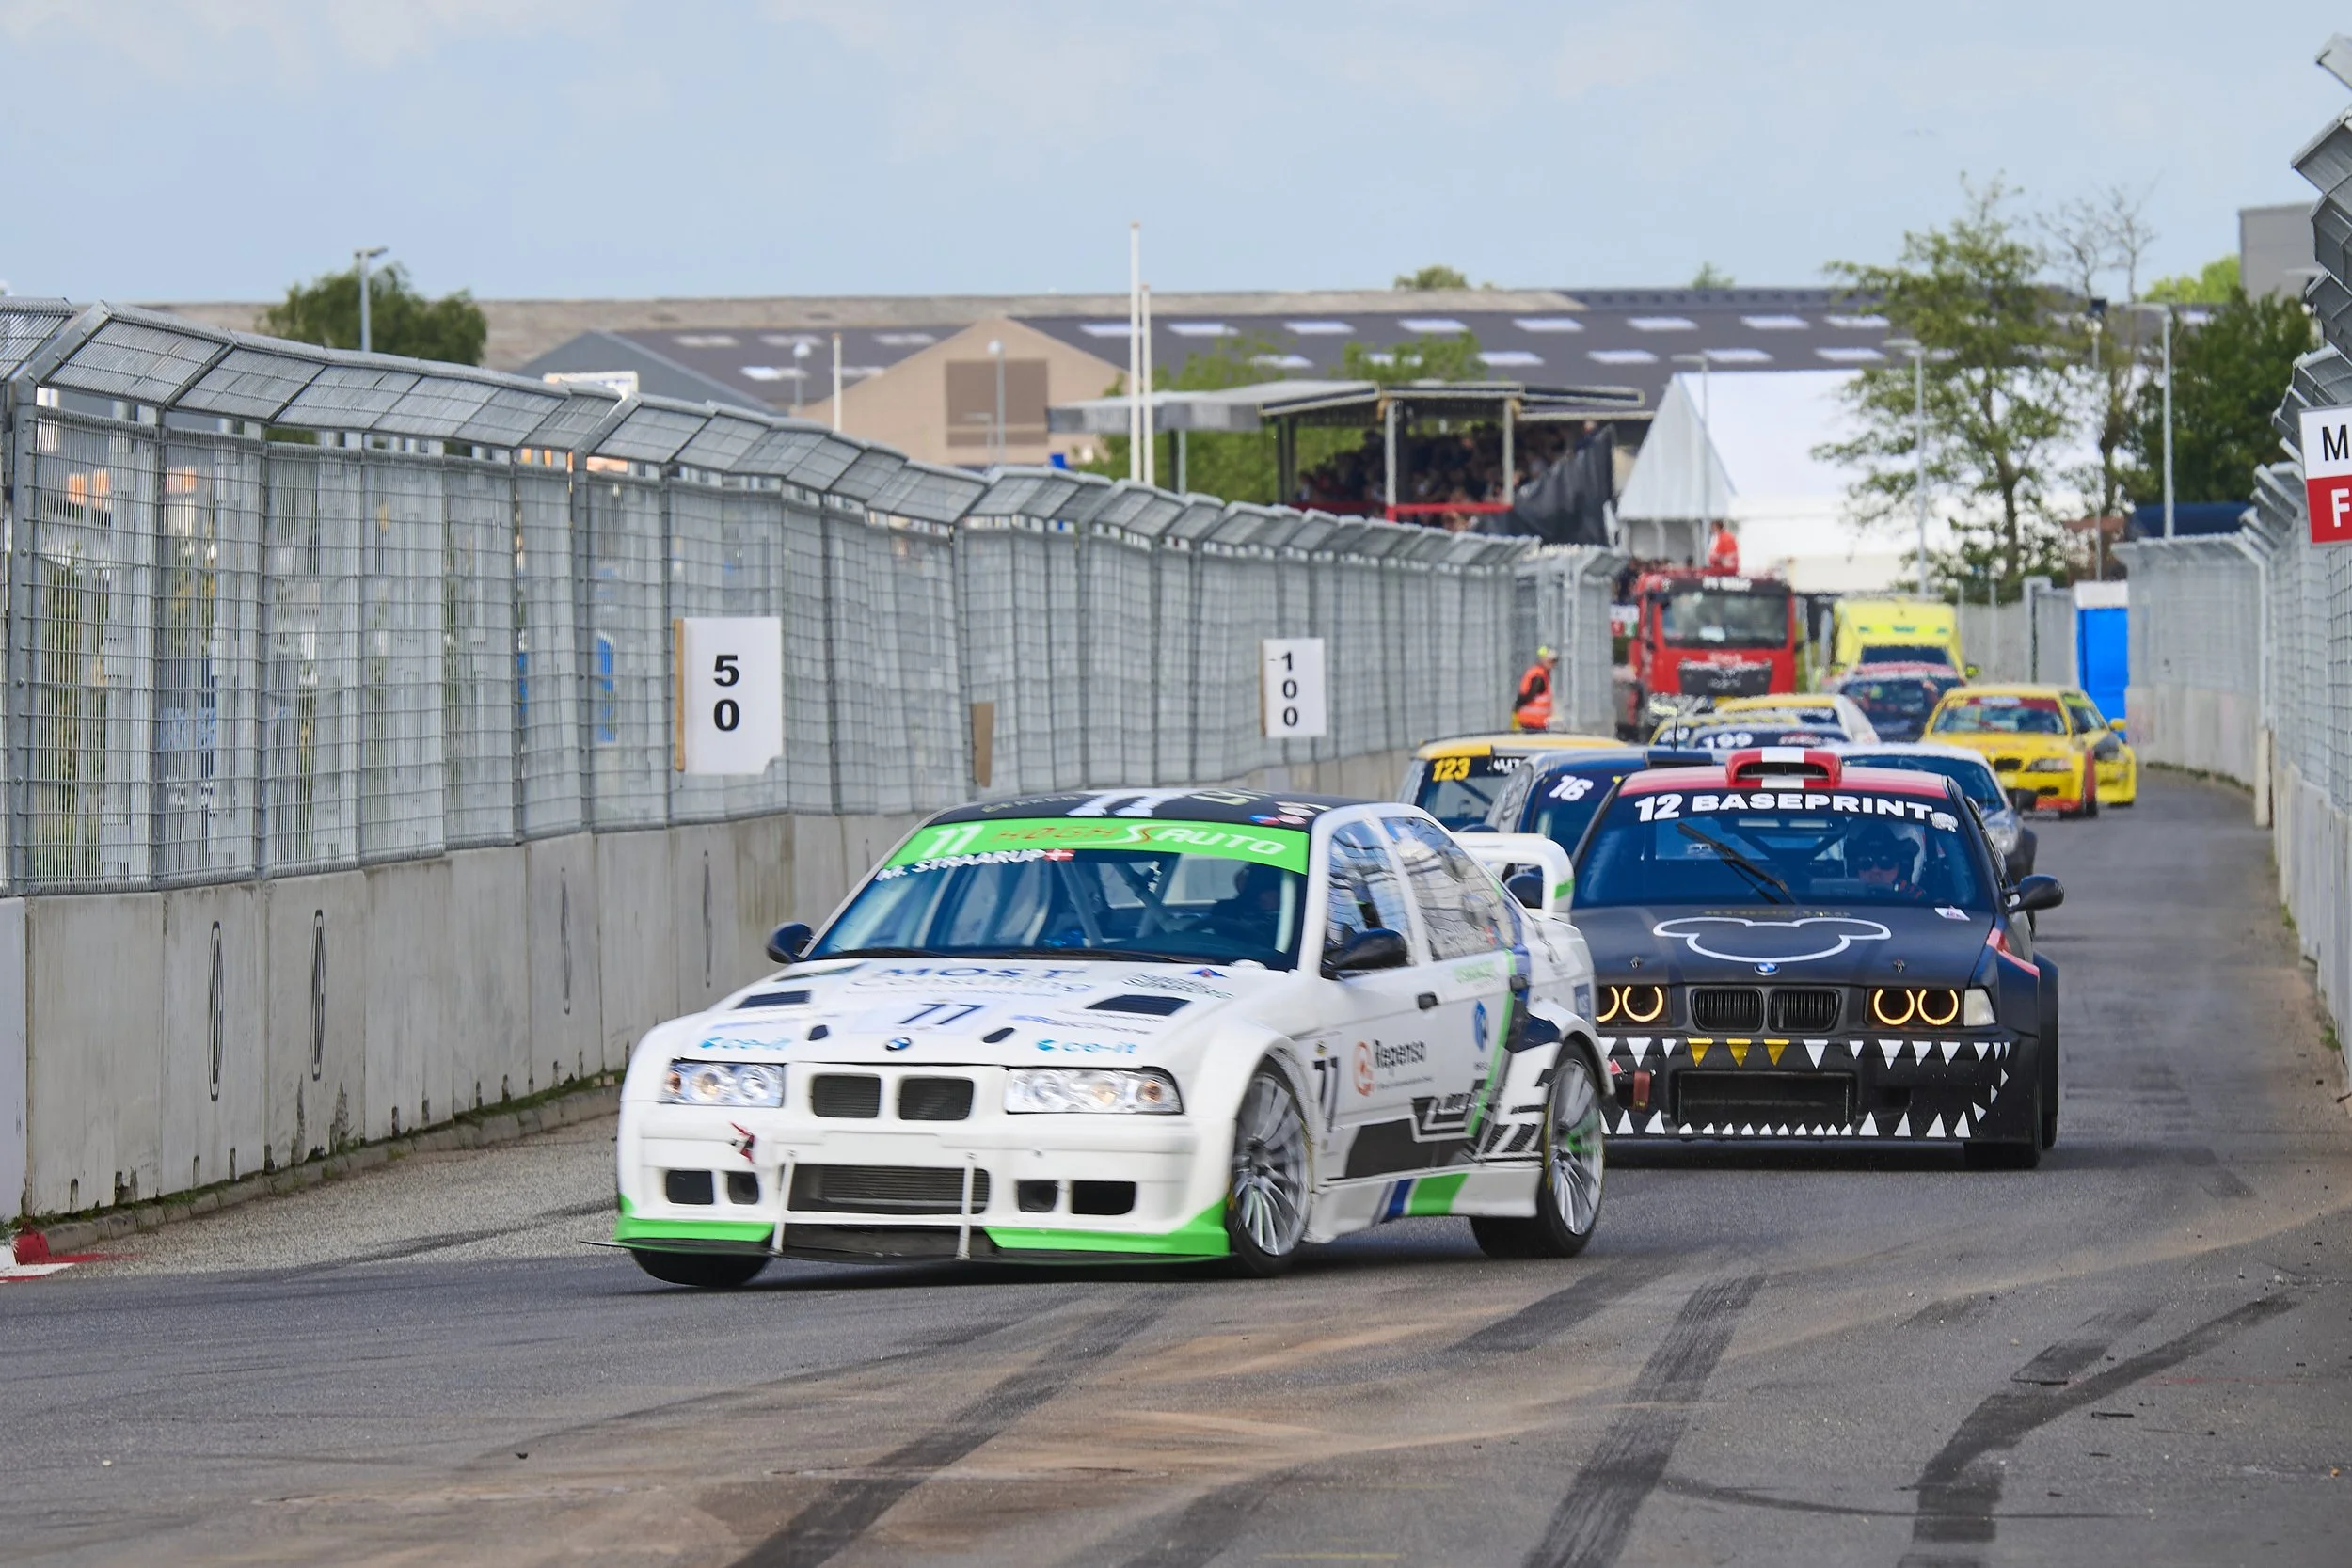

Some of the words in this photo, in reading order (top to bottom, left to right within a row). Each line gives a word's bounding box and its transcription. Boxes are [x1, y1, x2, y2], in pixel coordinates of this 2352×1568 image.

[2321, 424, 2350, 462] M
[2330, 487, 2351, 528] F
[713, 654, 740, 732] 50
[1280, 651, 1298, 727] 100
[1431, 756, 1471, 783] 123
[1549, 774, 1595, 801] 16
[1634, 793, 1684, 823] 12
